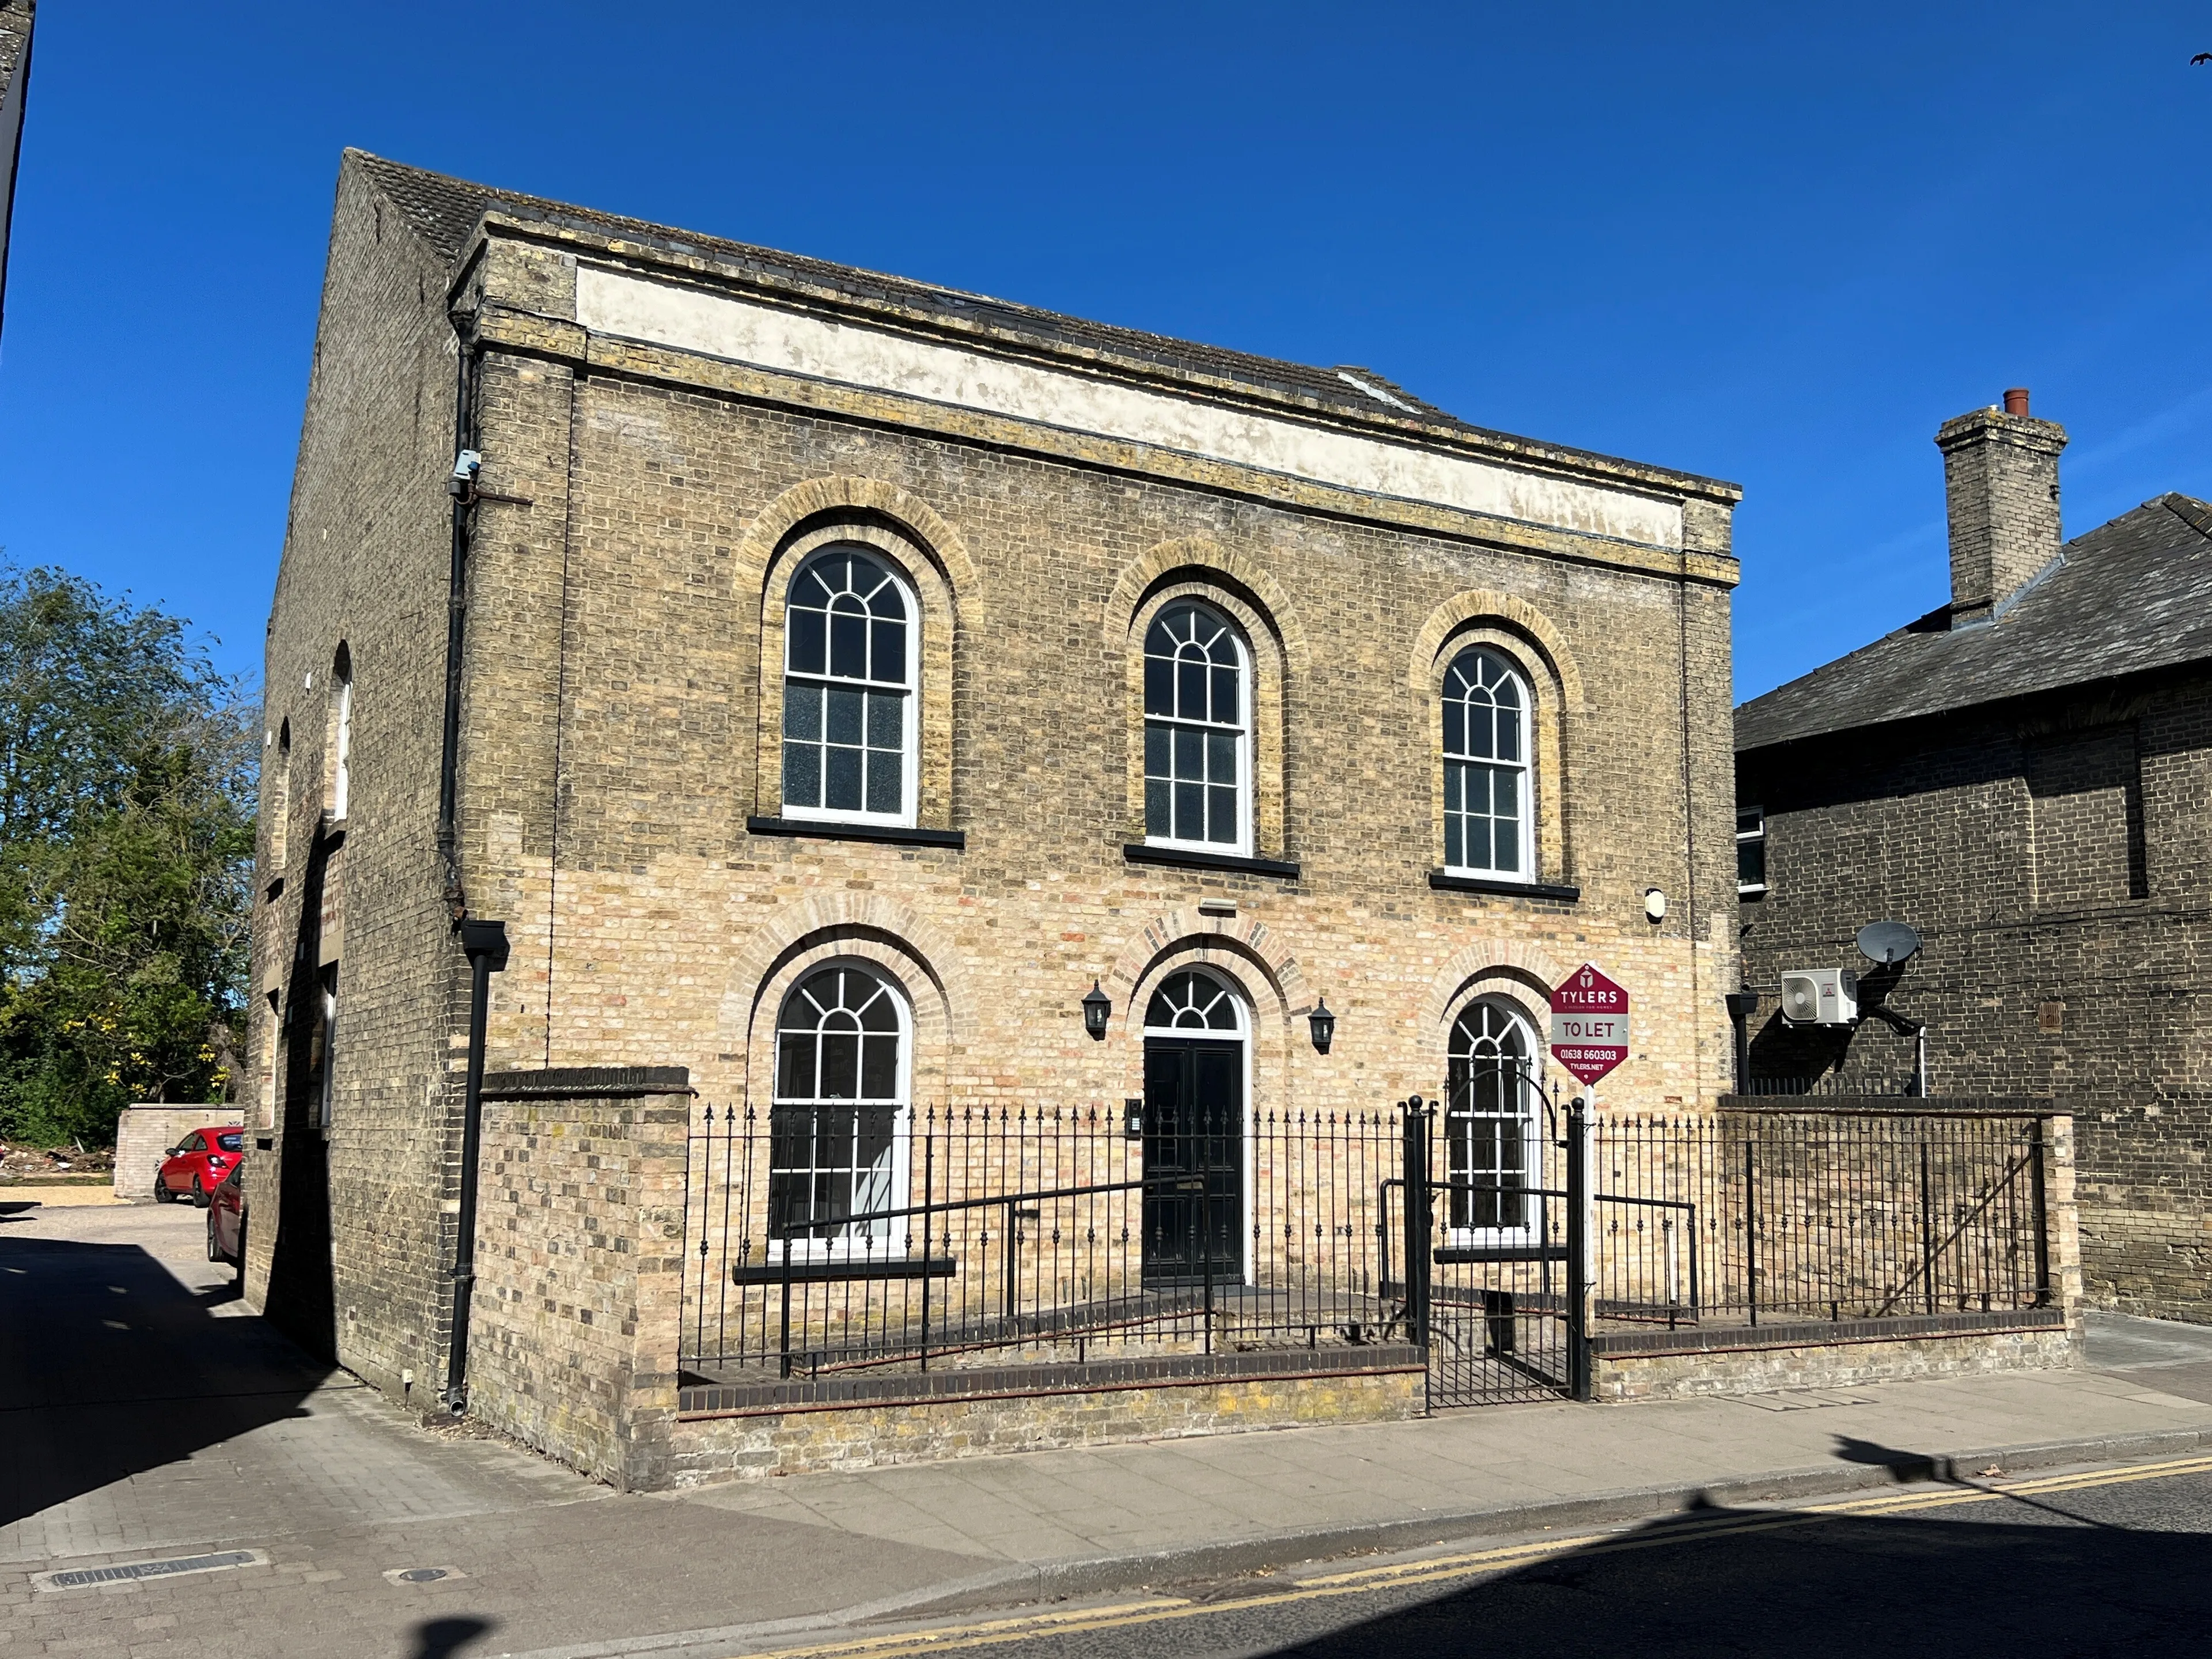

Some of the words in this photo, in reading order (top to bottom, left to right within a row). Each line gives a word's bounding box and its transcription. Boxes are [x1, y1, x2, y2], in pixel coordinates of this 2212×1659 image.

[1560, 991, 1618, 1003] TYLERS
[1562, 1022, 1581, 1037] TO
[1585, 1022, 1615, 1037] LET
[1560, 1049, 1582, 1059] 01638
[1584, 1050, 1617, 1060] 660303
